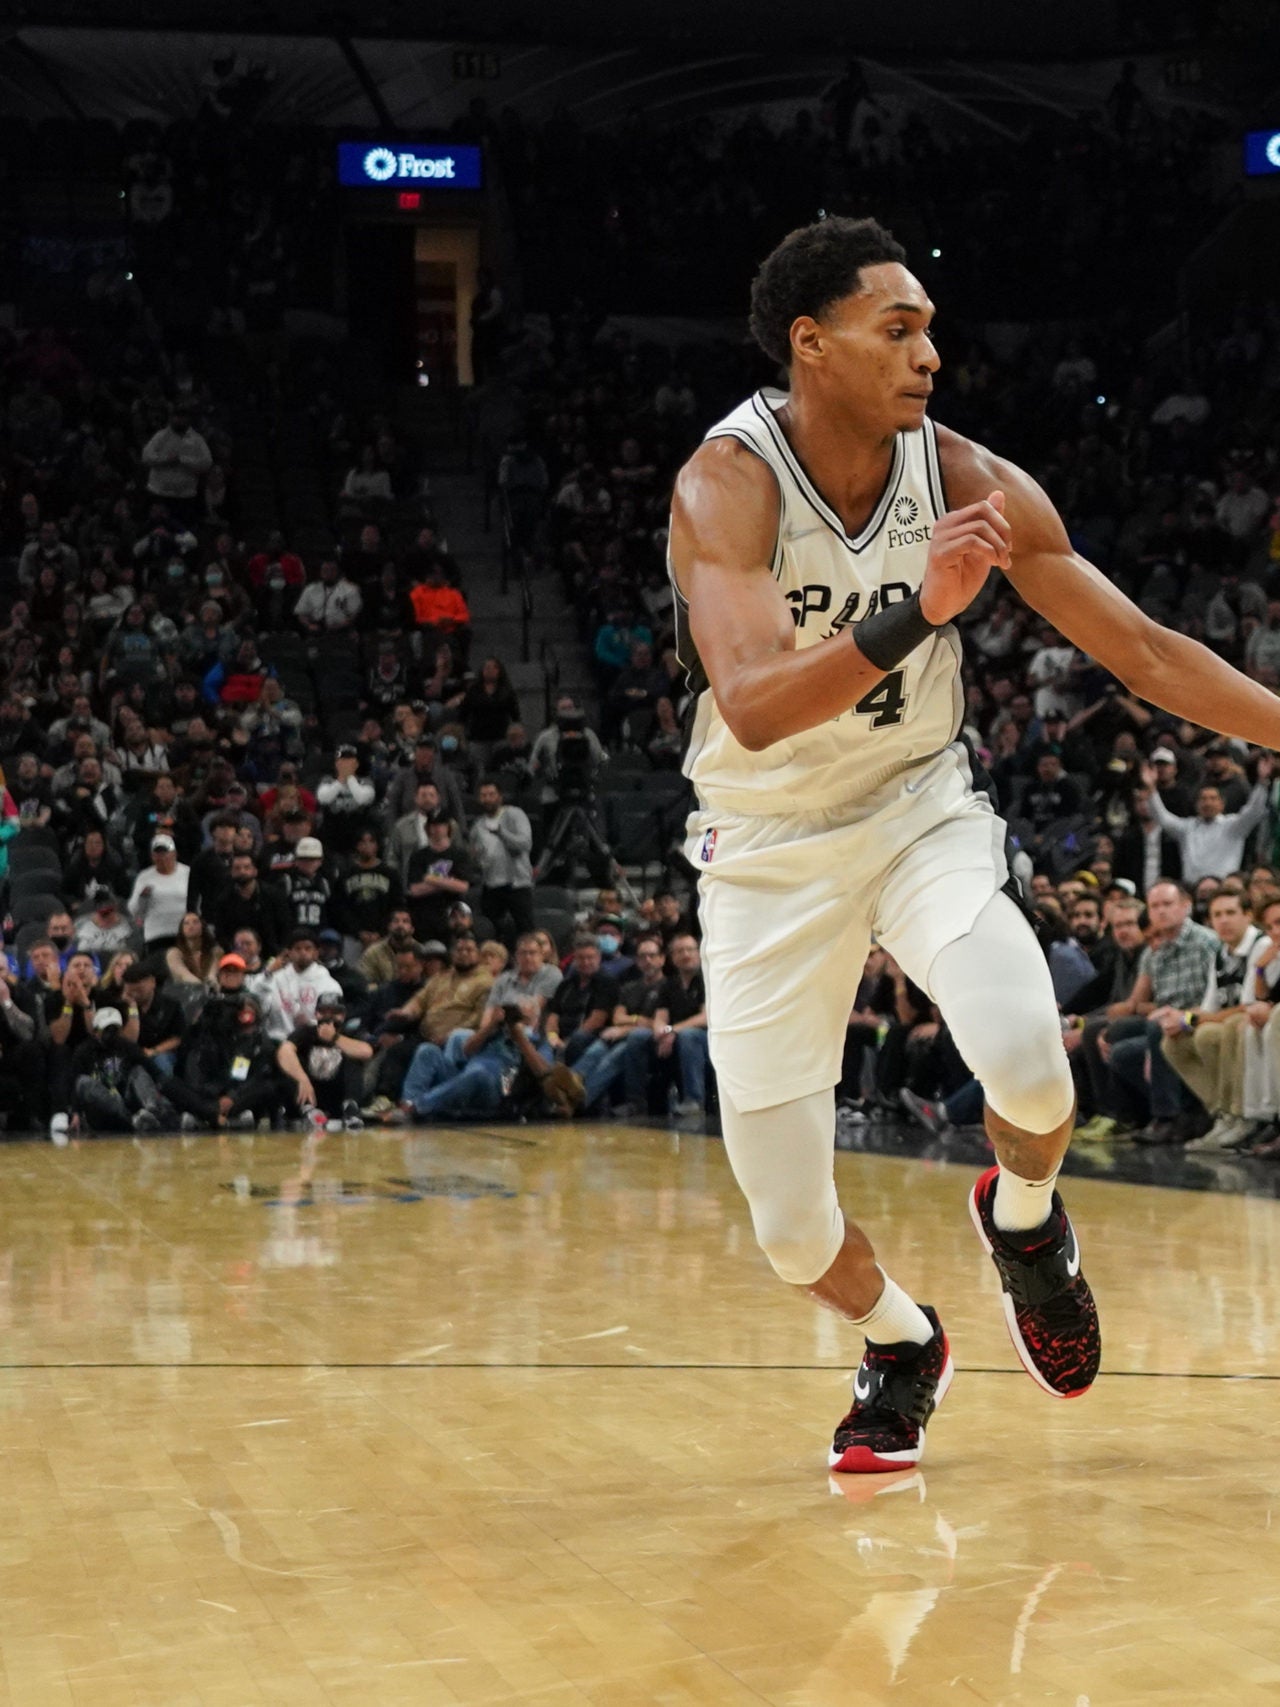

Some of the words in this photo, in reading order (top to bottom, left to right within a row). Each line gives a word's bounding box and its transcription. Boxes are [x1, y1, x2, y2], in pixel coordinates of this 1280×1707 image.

[398, 153, 456, 178] Frost
[887, 524, 932, 549] Frost
[785, 581, 923, 640] SPUR
